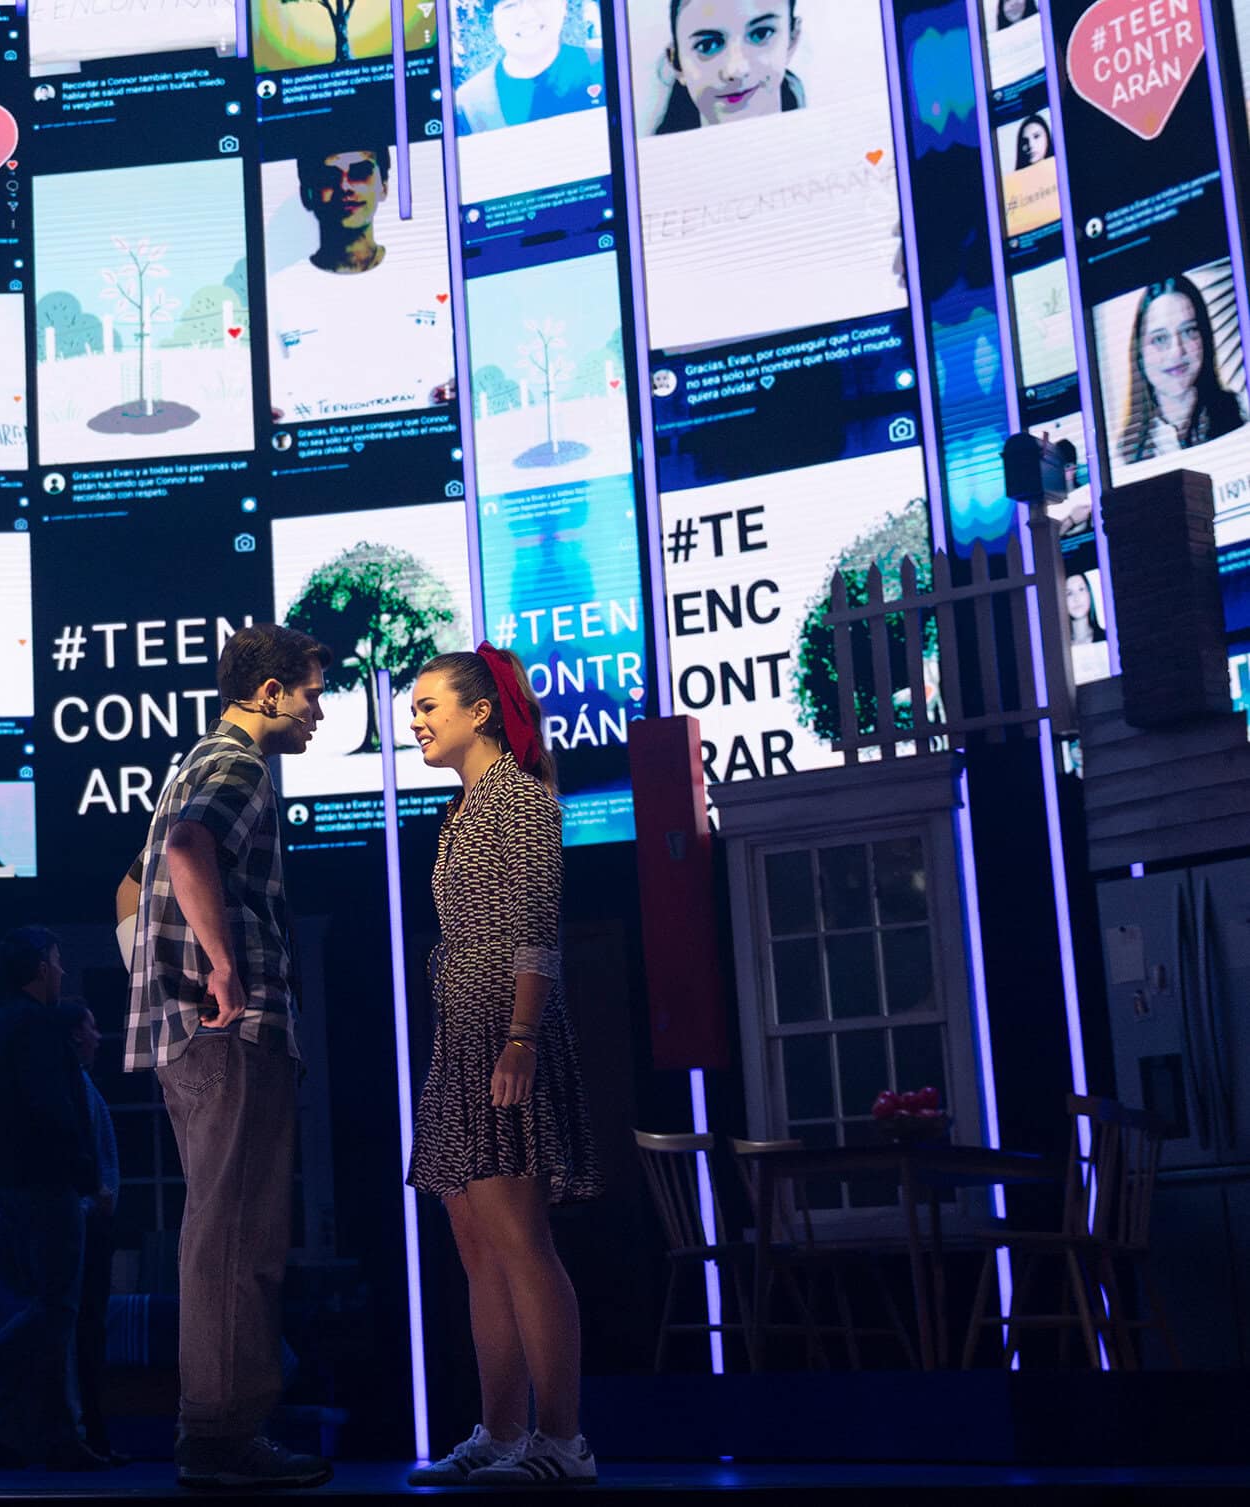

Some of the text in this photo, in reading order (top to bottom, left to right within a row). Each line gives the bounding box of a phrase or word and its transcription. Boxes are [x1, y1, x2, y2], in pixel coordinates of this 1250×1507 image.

[1091, 0, 1189, 53] #TEEN
[294, 73, 329, 84] podemos
[331, 69, 360, 78] cambiar
[370, 65, 385, 73] que
[407, 59, 425, 68] pero
[1093, 20, 1194, 82] CONTR
[62, 81, 98, 90] Recordar
[107, 77, 137, 86] Connor
[139, 73, 172, 82] también
[174, 70, 209, 80] significa
[62, 92, 88, 100] hablar
[102, 88, 124, 97] salud
[126, 85, 154, 94] mental
[199, 78, 226, 86] miedo
[282, 85, 317, 94] podemos
[318, 80, 348, 89] cambiar
[283, 94, 308, 104] demás
[309, 91, 332, 100] desde
[1111, 57, 1182, 109] ARÁN
[686, 337, 901, 389] no sea solo un nombre que todo el mundo
[756, 350, 774, 362] por
[776, 338, 827, 356] conseguir
[829, 334, 850, 346] que
[851, 326, 890, 340] Connor
[687, 390, 719, 404] quiera
[351, 424, 364, 433] por
[366, 420, 403, 430] conseguir
[404, 419, 419, 427] que
[420, 416, 449, 424] Connor
[354, 432, 384, 443] nombre
[401, 428, 419, 436] todo
[429, 424, 456, 433] mundo
[72, 472, 104, 480] Gracias
[113, 469, 134, 477] Evan
[149, 466, 174, 474] todas
[190, 463, 229, 473] personas
[231, 462, 248, 470] que
[299, 449, 323, 458] quiera
[73, 483, 97, 491] están
[98, 480, 137, 489] haciendo
[138, 479, 154, 488] que
[155, 477, 187, 485] Connor
[73, 492, 116, 501] recordado
[117, 491, 135, 499] con
[667, 504, 768, 564] #TE
[495, 597, 639, 648] #TEEN
[672, 579, 781, 637] ENC
[52, 615, 253, 671] #TEEN
[527, 652, 644, 699] ONTR
[678, 650, 791, 709] ONT
[53, 689, 219, 743] CONT
[546, 703, 628, 750] RÁN
[701, 729, 798, 784] RAR
[77, 752, 184, 815] AR
